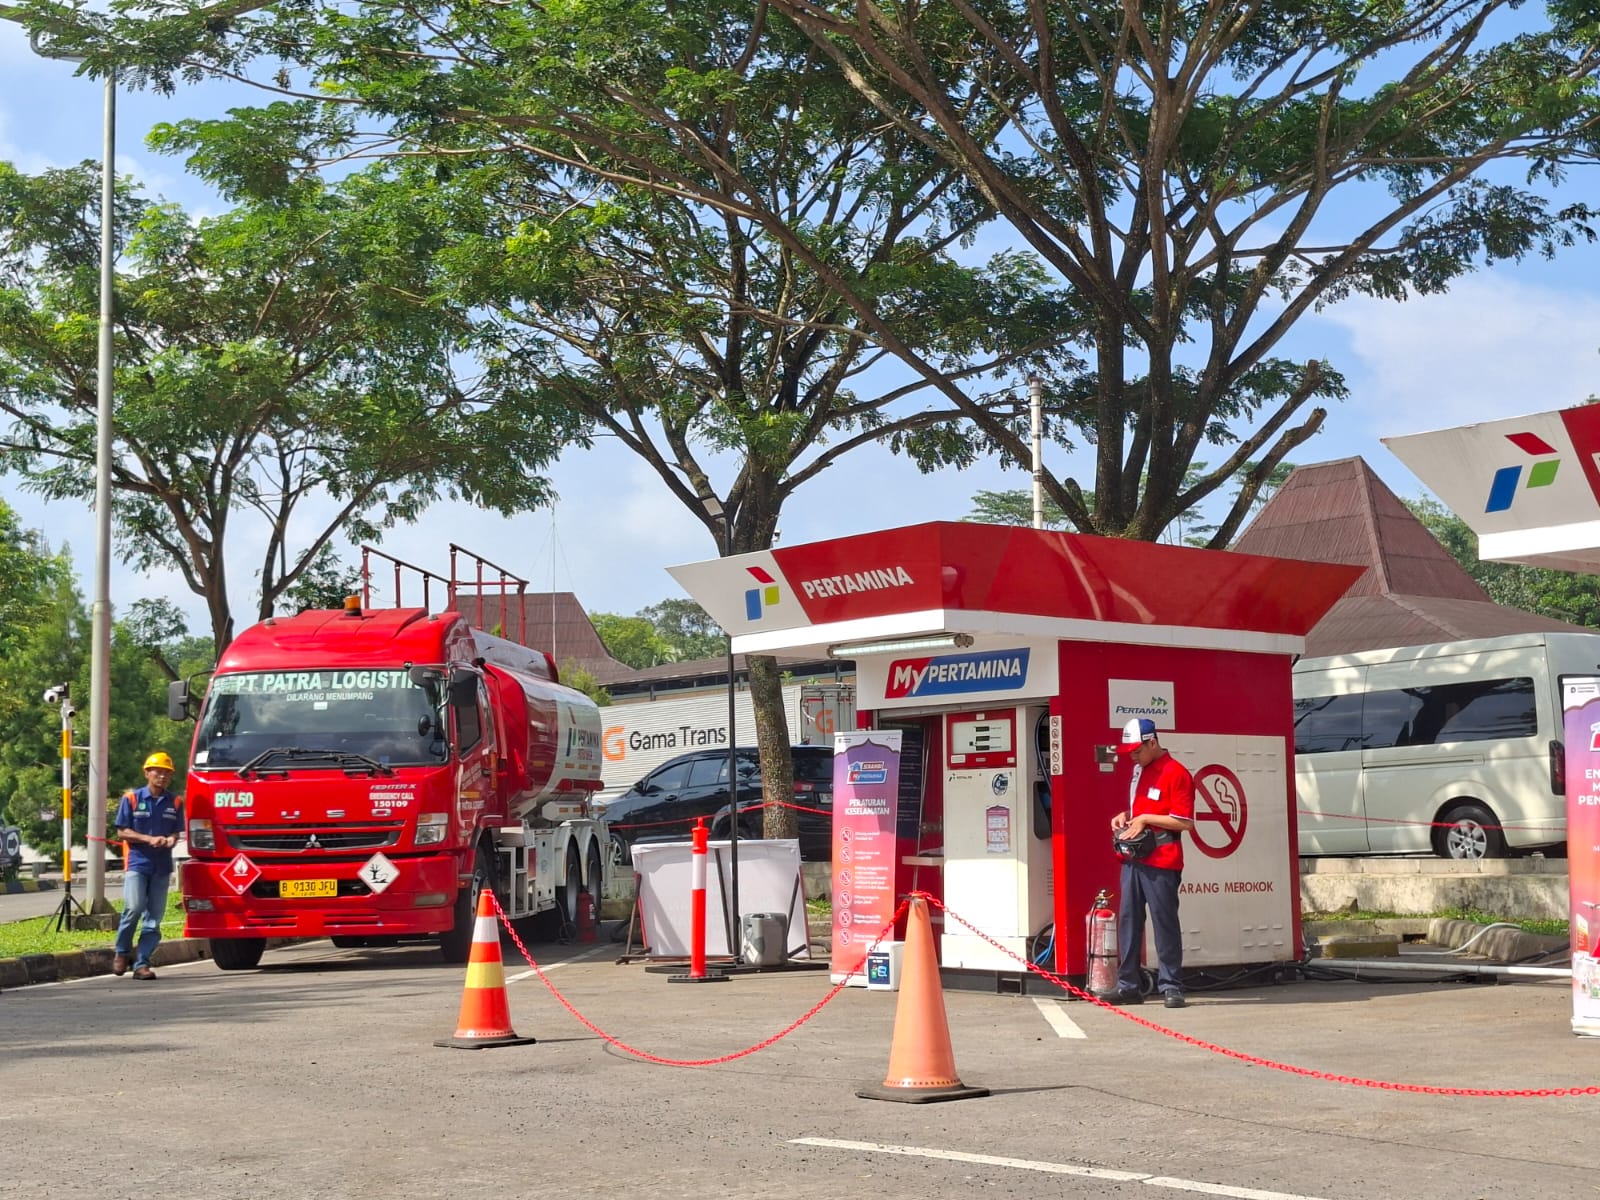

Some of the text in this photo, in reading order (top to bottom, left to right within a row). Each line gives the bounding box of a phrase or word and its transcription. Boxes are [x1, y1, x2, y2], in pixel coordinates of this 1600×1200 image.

[801, 566, 914, 599] PERTAMINA
[236, 675, 259, 692] PT
[263, 673, 324, 691] PATRA
[286, 692, 373, 702] DILARANG MENUMPANG
[815, 709, 834, 734] G
[602, 726, 625, 761] G
[629, 731, 676, 750] Gama
[679, 726, 726, 746] Trans
[214, 792, 254, 808] BYL50
[374, 800, 408, 808] 150109
[848, 799, 886, 807] PERATURAN
[236, 808, 392, 819] FUSO
[845, 808, 890, 816] KESELAMATAN
[1224, 882, 1273, 893] MEROKOK
